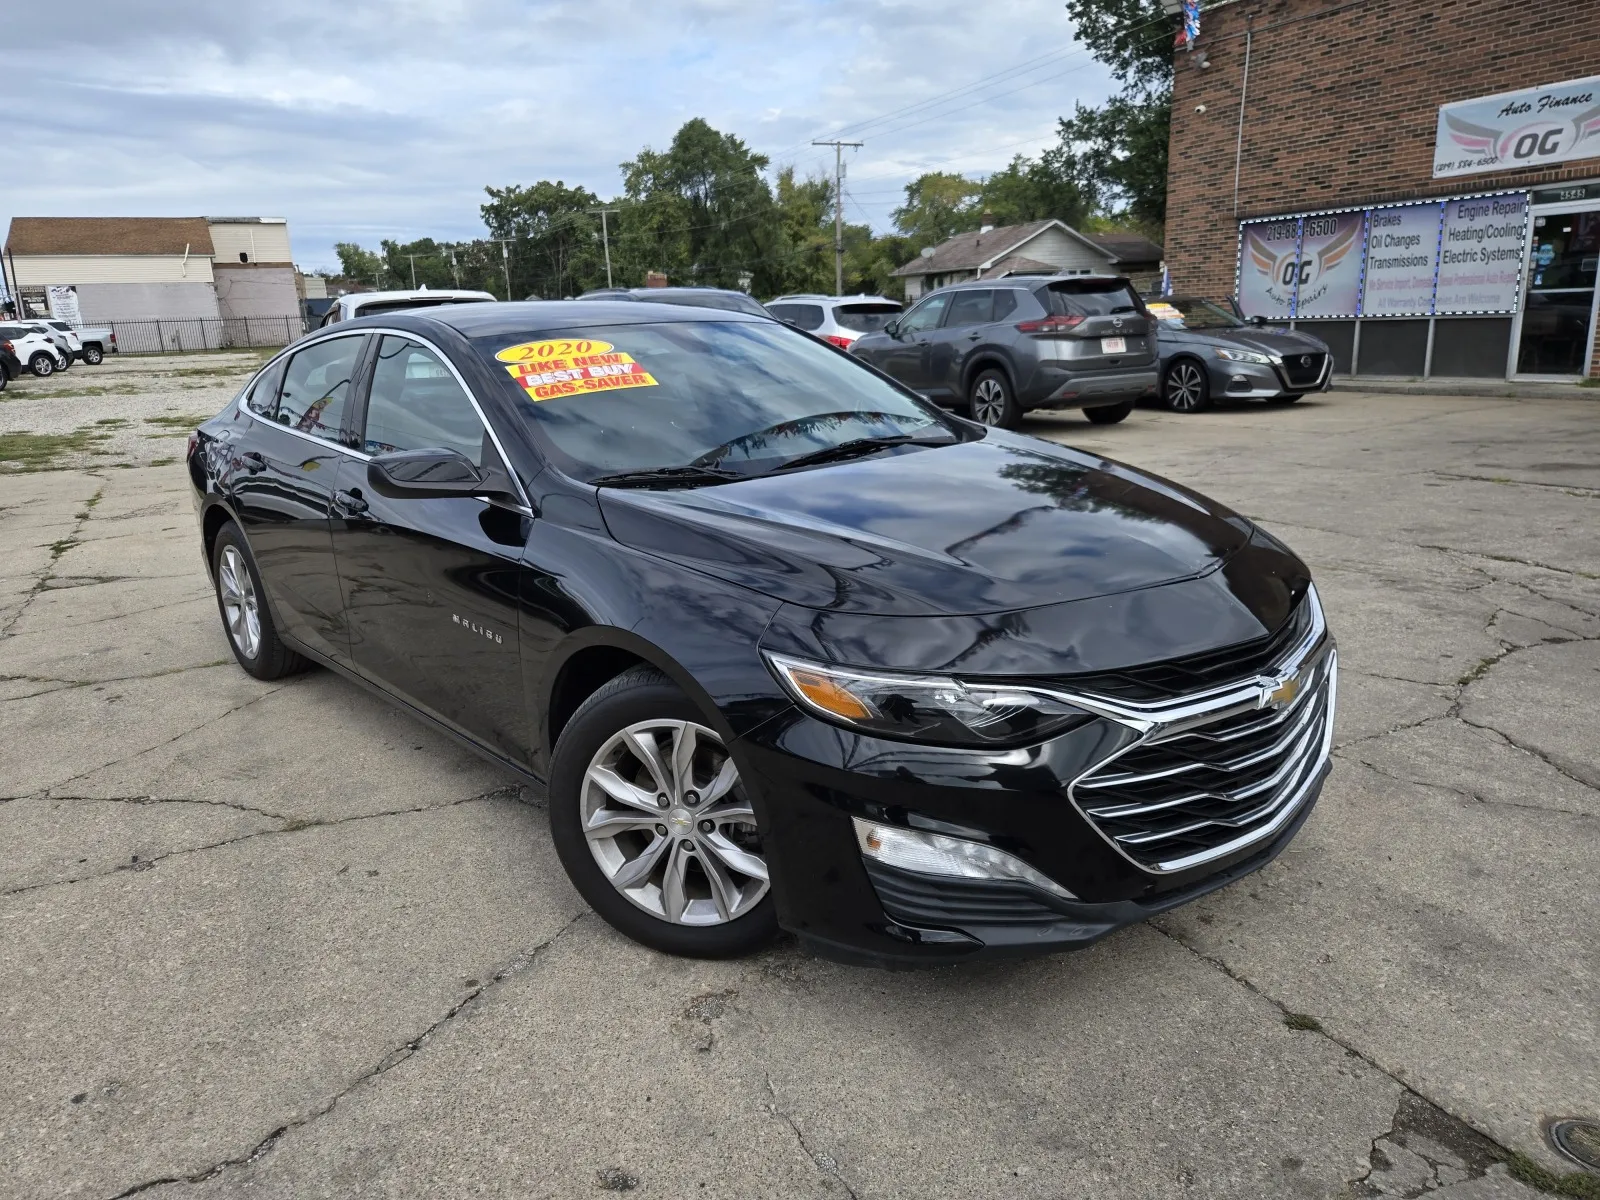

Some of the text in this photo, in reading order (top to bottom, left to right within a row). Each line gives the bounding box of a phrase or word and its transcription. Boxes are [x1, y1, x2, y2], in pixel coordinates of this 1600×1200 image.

[1497, 93, 1593, 118] Auto Finance
[1513, 128, 1564, 159] OG
[1373, 213, 1402, 228] Brakes
[1457, 199, 1525, 221] Engine Repair
[1267, 218, 1337, 241] 219-88-6500
[1448, 222, 1523, 243] Heating/Cooling
[1371, 233, 1421, 250] Oil Changes
[1369, 253, 1428, 270] Transmissions
[1443, 247, 1478, 265] Electric
[1479, 247, 1520, 265] Systems
[1282, 260, 1312, 286] OG
[519, 341, 592, 360] 2020
[518, 353, 622, 375] LIKE NEW
[525, 364, 633, 387] BEST BUY
[534, 374, 646, 398] GAS-SAVER
[452, 613, 502, 644] MALIBU
